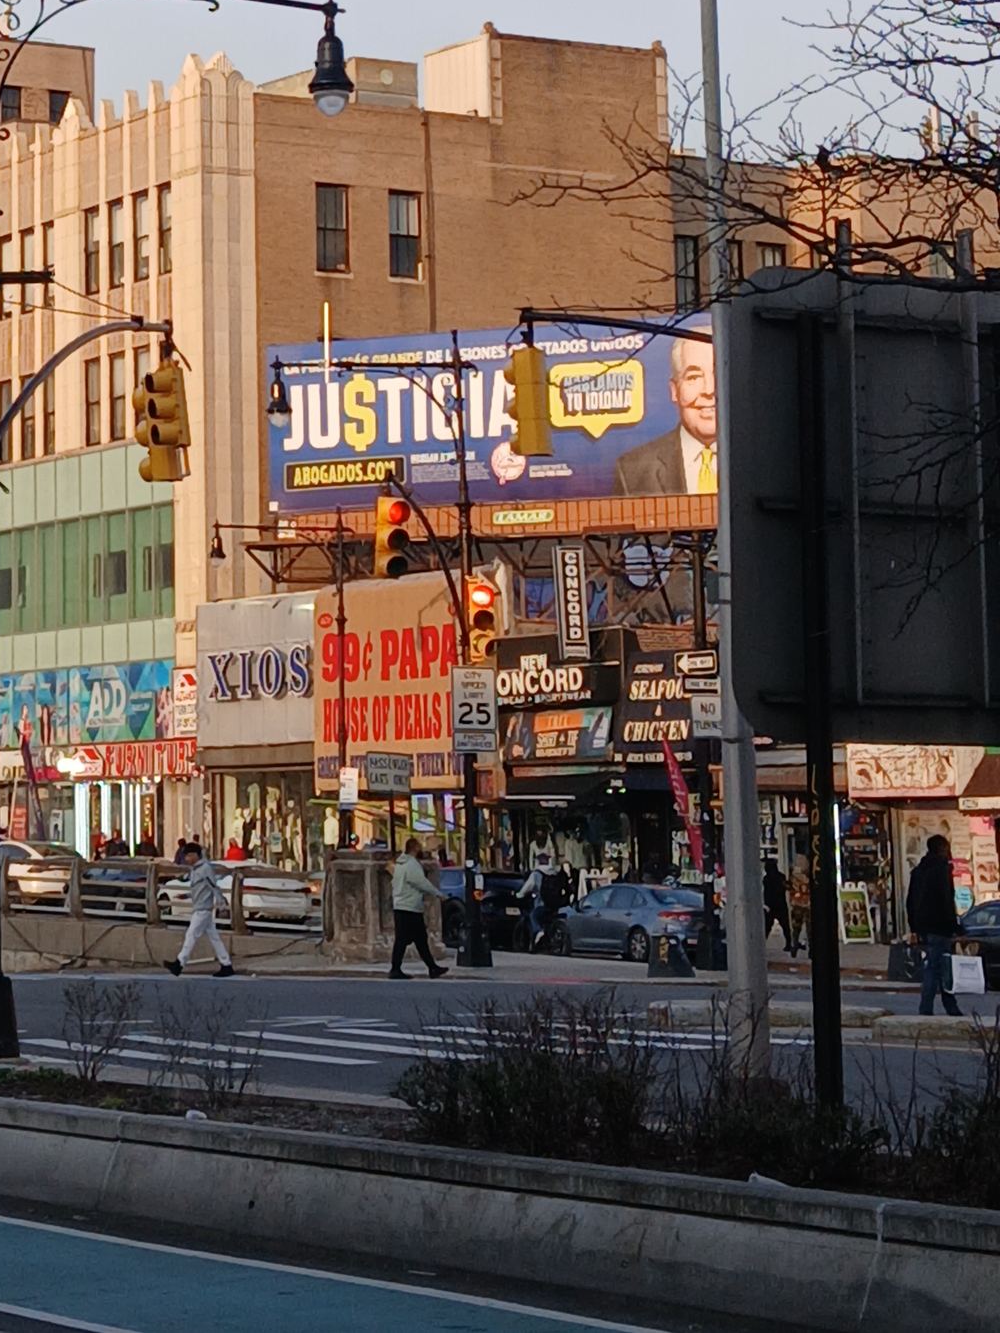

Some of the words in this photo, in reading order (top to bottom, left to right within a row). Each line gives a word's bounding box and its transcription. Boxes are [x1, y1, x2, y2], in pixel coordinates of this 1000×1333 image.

[447, 344, 507, 363] LSIONES
[564, 552, 582, 640] CONCORD
[629, 678, 692, 701] SEAFOO
[371, 695, 390, 743] OF
[394, 691, 442, 742] DEALS
[458, 702, 491, 726] 25
[700, 701, 717, 715] NO
[623, 718, 691, 743] CHICKEN
